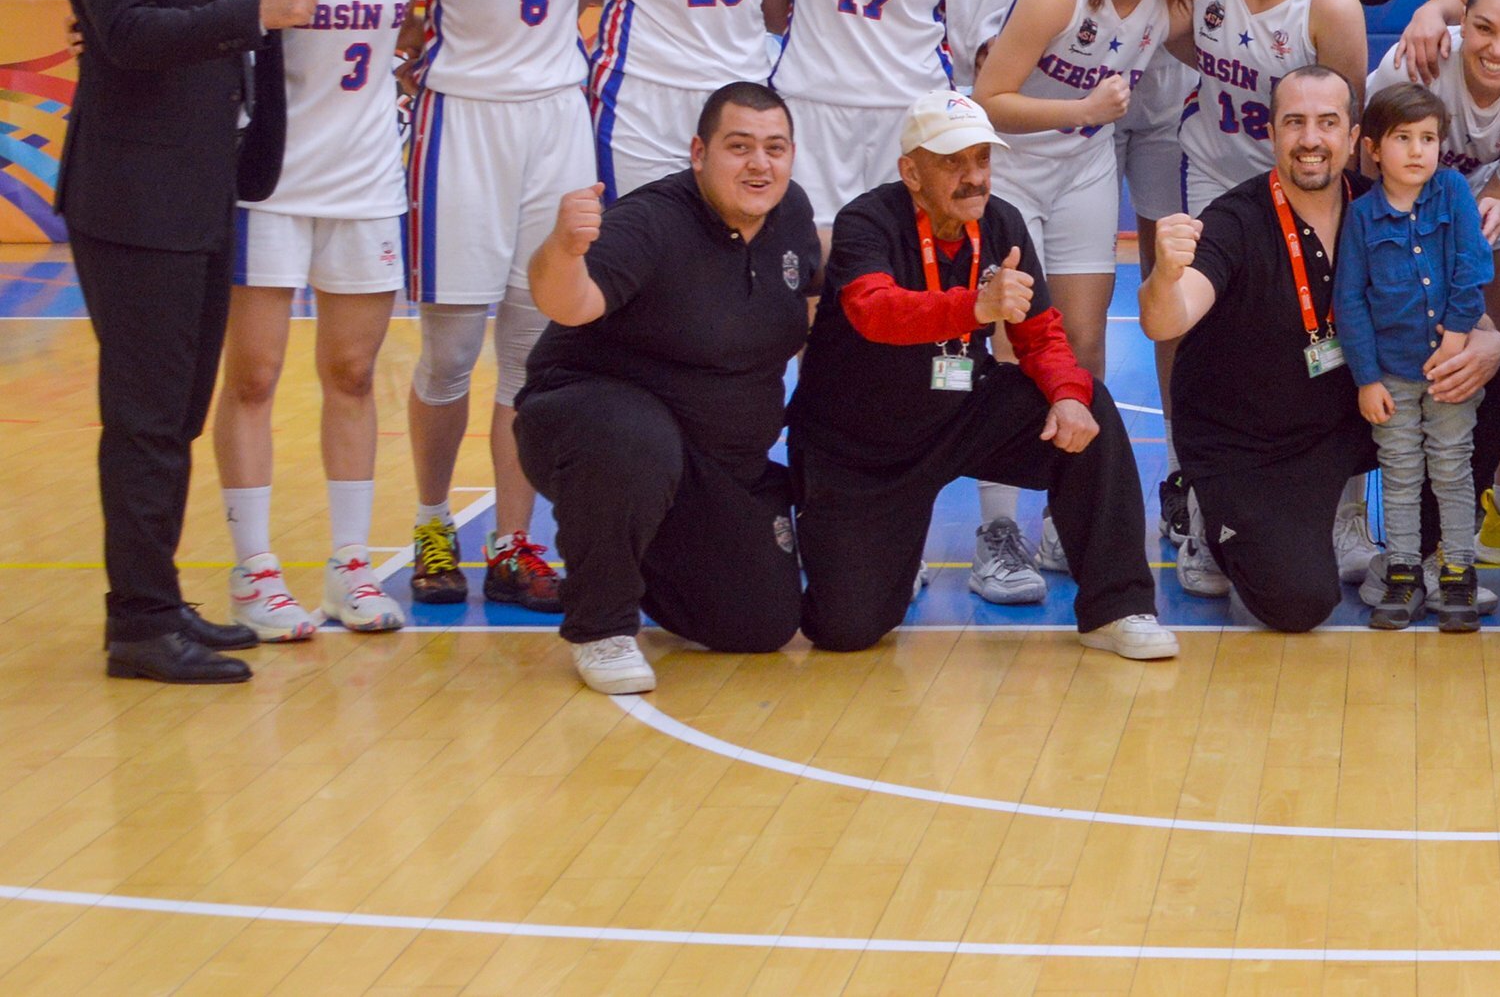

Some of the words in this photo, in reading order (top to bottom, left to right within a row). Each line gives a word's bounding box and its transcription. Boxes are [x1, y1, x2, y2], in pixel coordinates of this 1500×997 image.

[294, 1, 383, 30] RSİN
[340, 42, 372, 91] 3
[1218, 90, 1270, 141] 12
